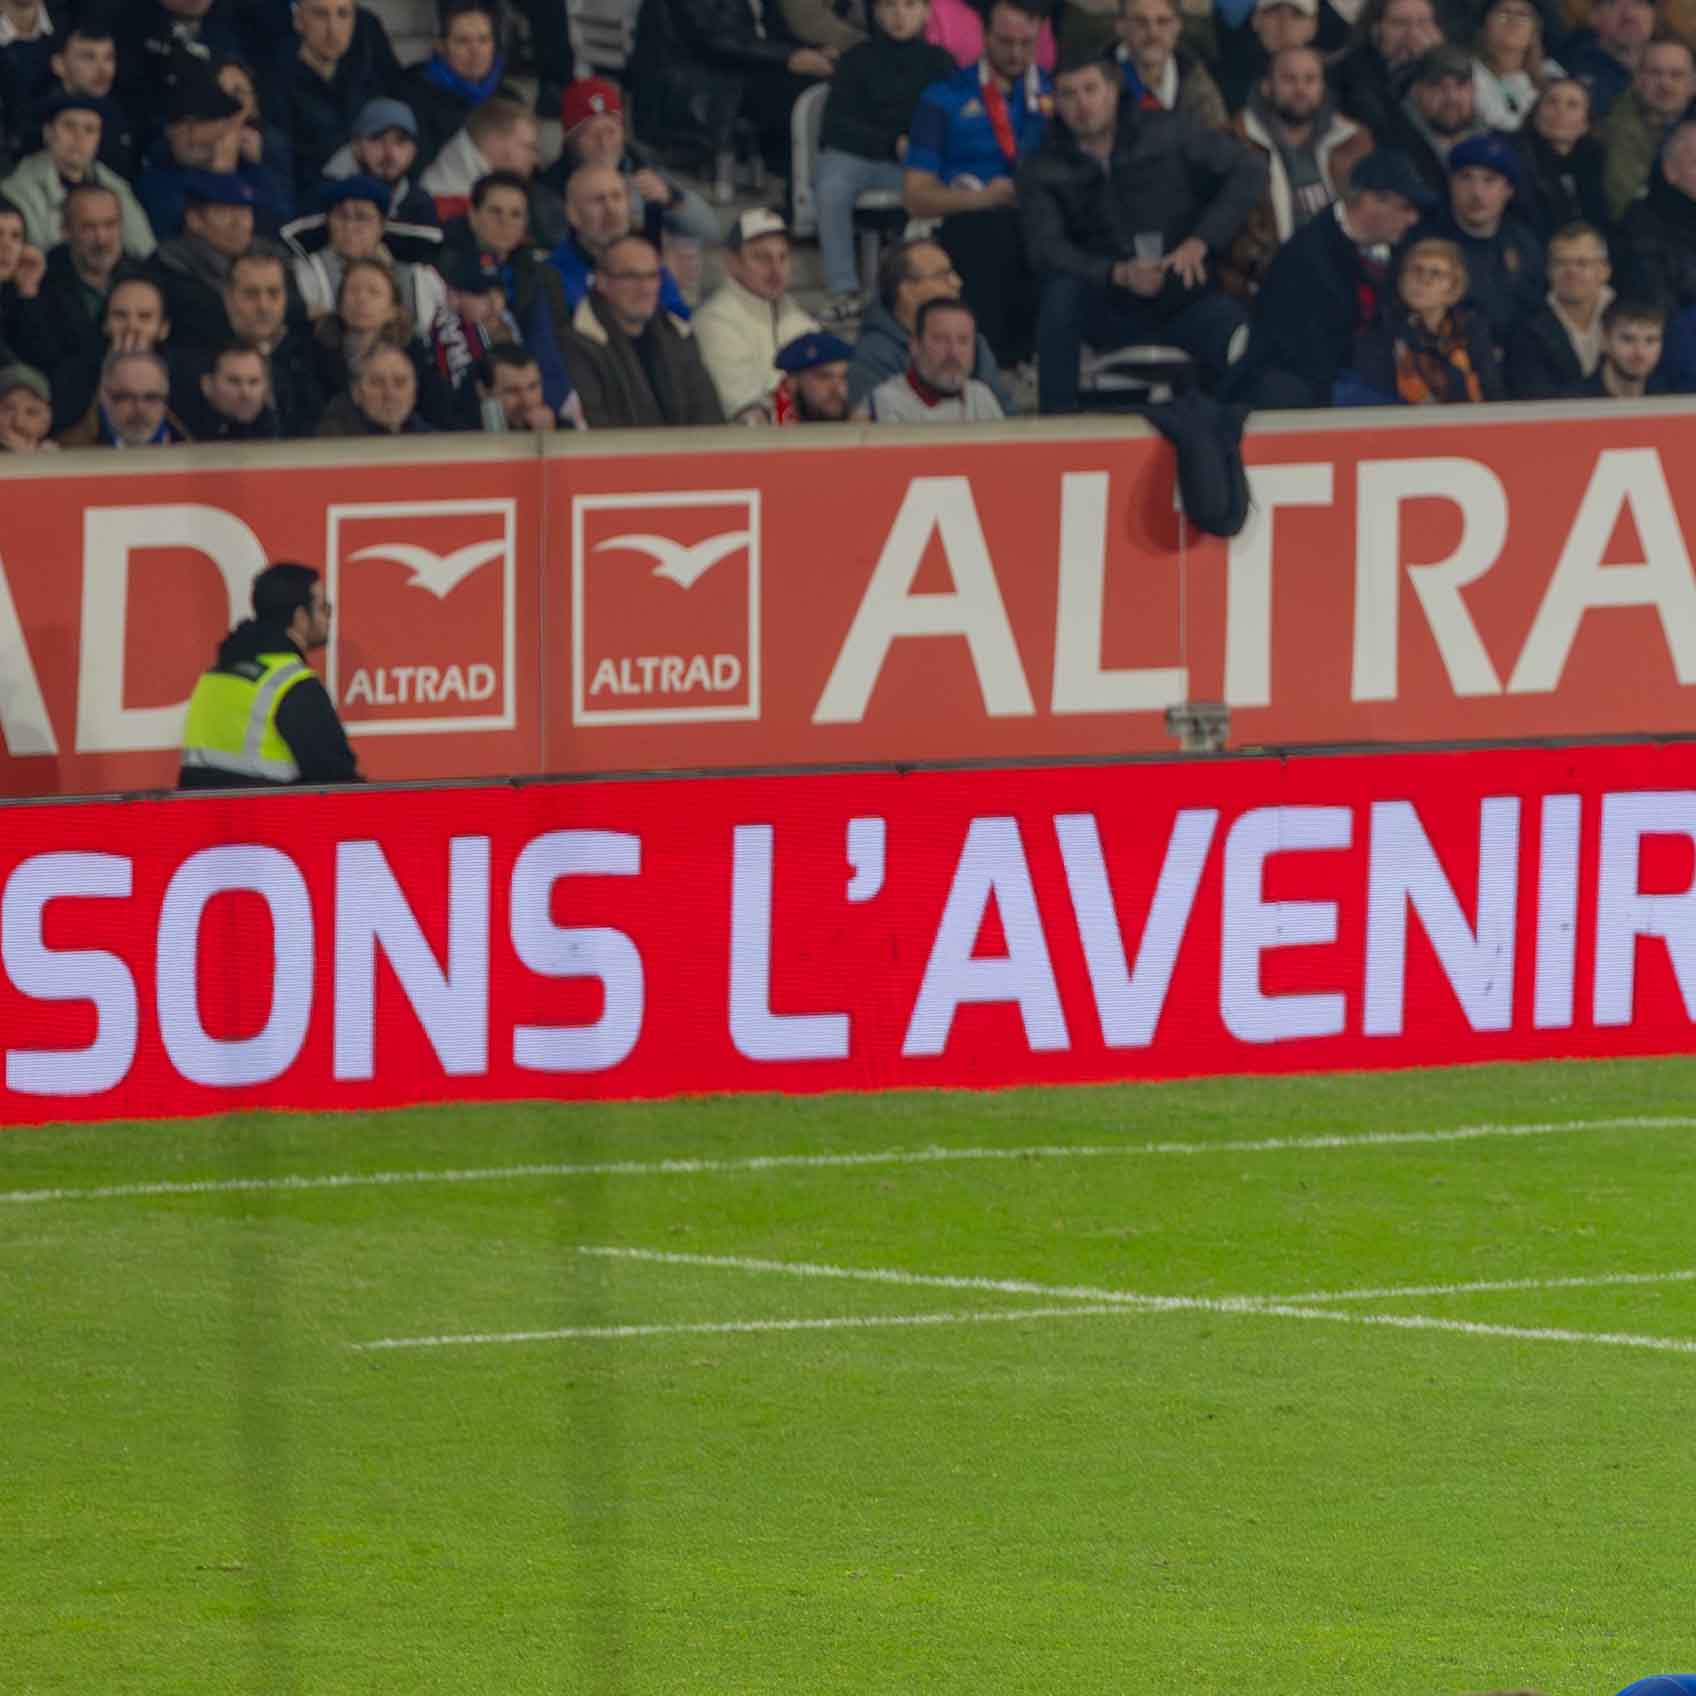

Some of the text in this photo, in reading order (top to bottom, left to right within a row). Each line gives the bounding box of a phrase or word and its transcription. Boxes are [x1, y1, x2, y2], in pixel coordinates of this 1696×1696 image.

[345, 663, 497, 704] ALTRAD
[589, 654, 742, 695] ALTRAD
[0, 828, 644, 1096] SONS
